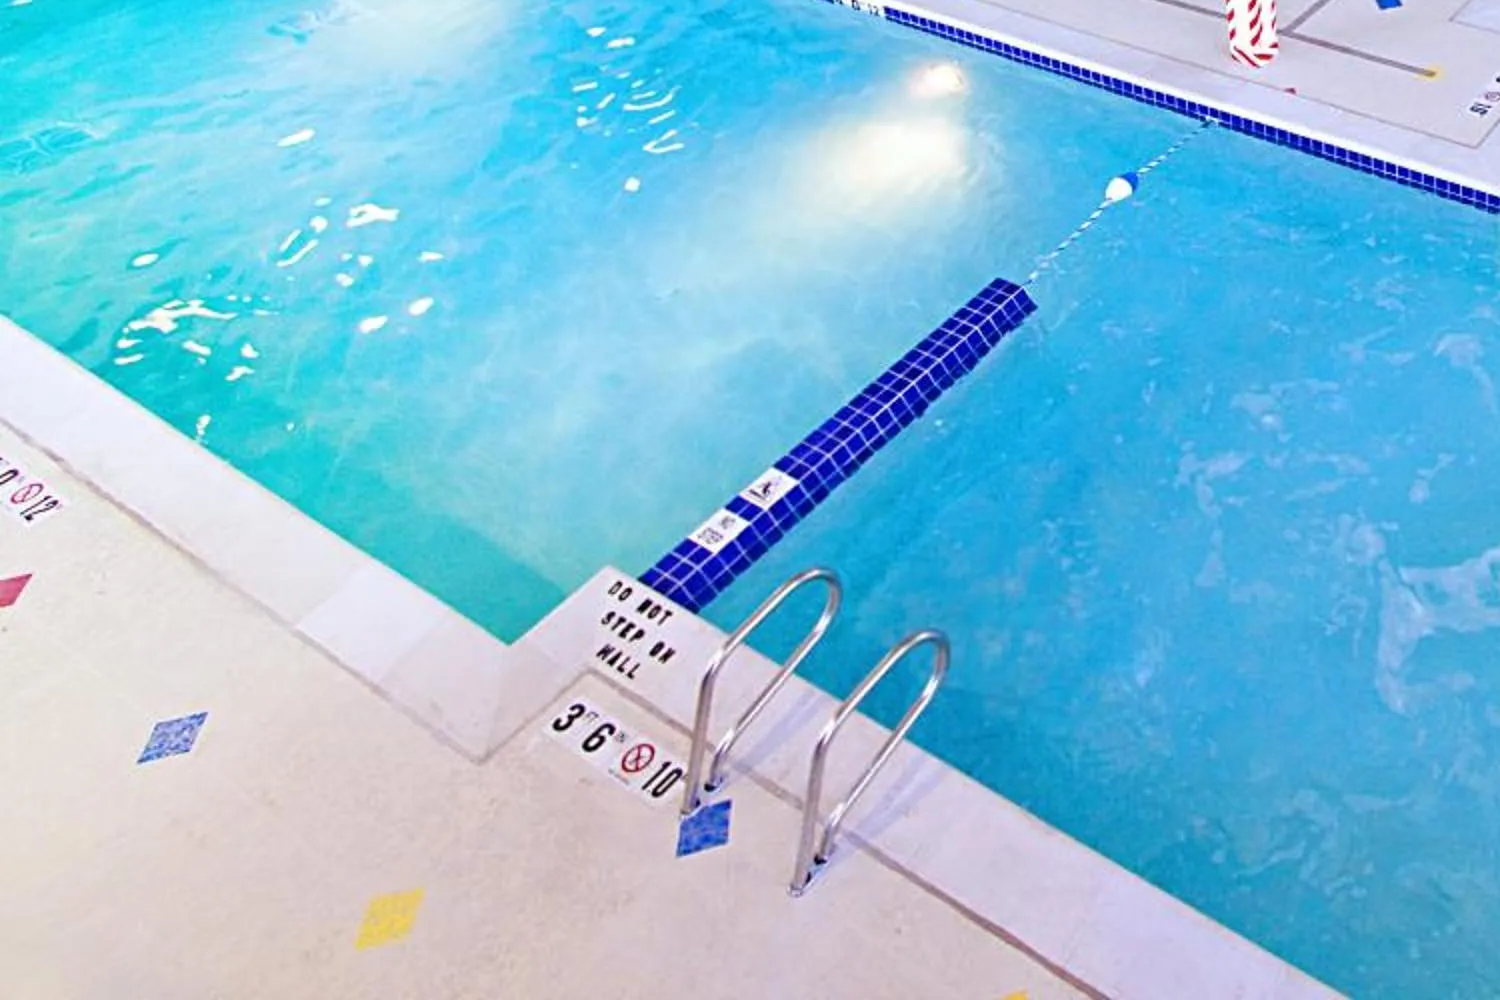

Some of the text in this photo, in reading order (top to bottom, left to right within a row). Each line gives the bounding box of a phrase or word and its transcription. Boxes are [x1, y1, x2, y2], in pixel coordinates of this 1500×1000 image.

[19, 495, 59, 521] 12
[608, 580, 674, 626] DO NOT
[601, 611, 676, 664] STEP ON
[596, 643, 641, 680] WALL
[552, 703, 586, 732] 3
[581, 723, 617, 753] 6
